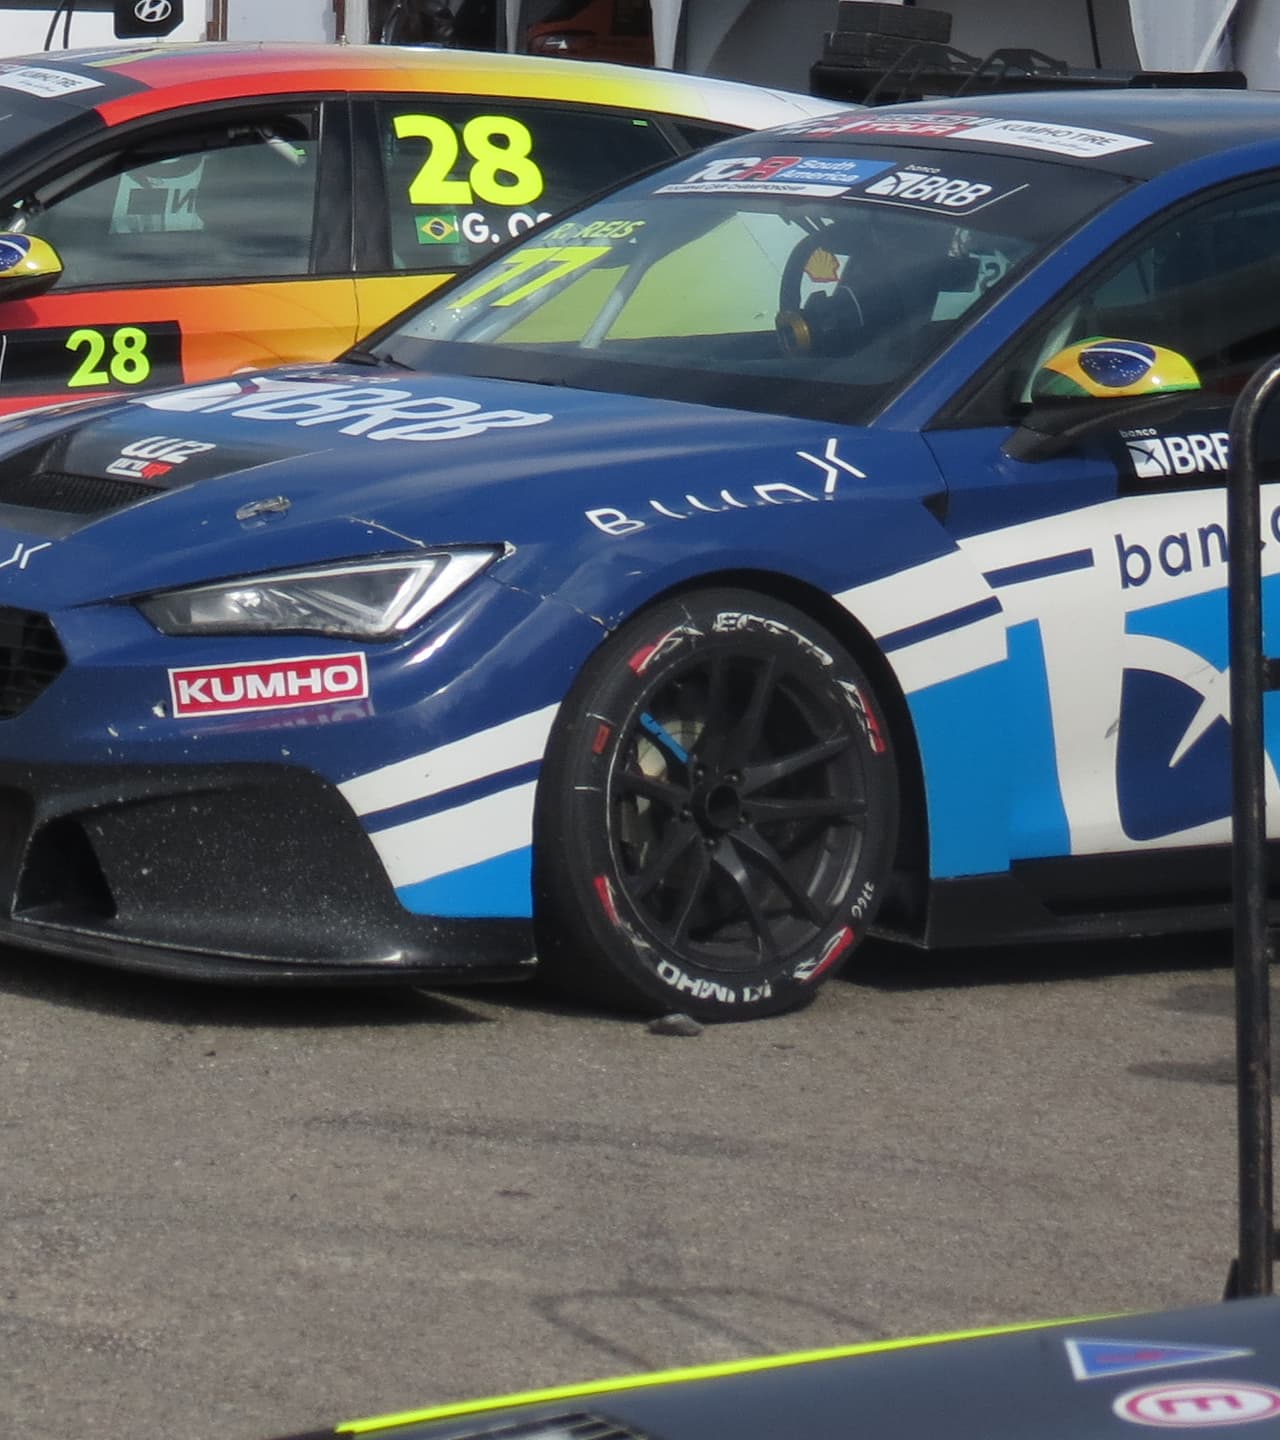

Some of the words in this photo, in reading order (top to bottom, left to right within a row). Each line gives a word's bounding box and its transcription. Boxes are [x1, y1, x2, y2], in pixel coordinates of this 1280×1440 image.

[393, 114, 544, 207] 28
[902, 172, 993, 207] BRB
[462, 212, 500, 243] G.
[65, 327, 151, 388] 28
[231, 386, 554, 442] BRB
[178, 664, 359, 708] KUMHO
